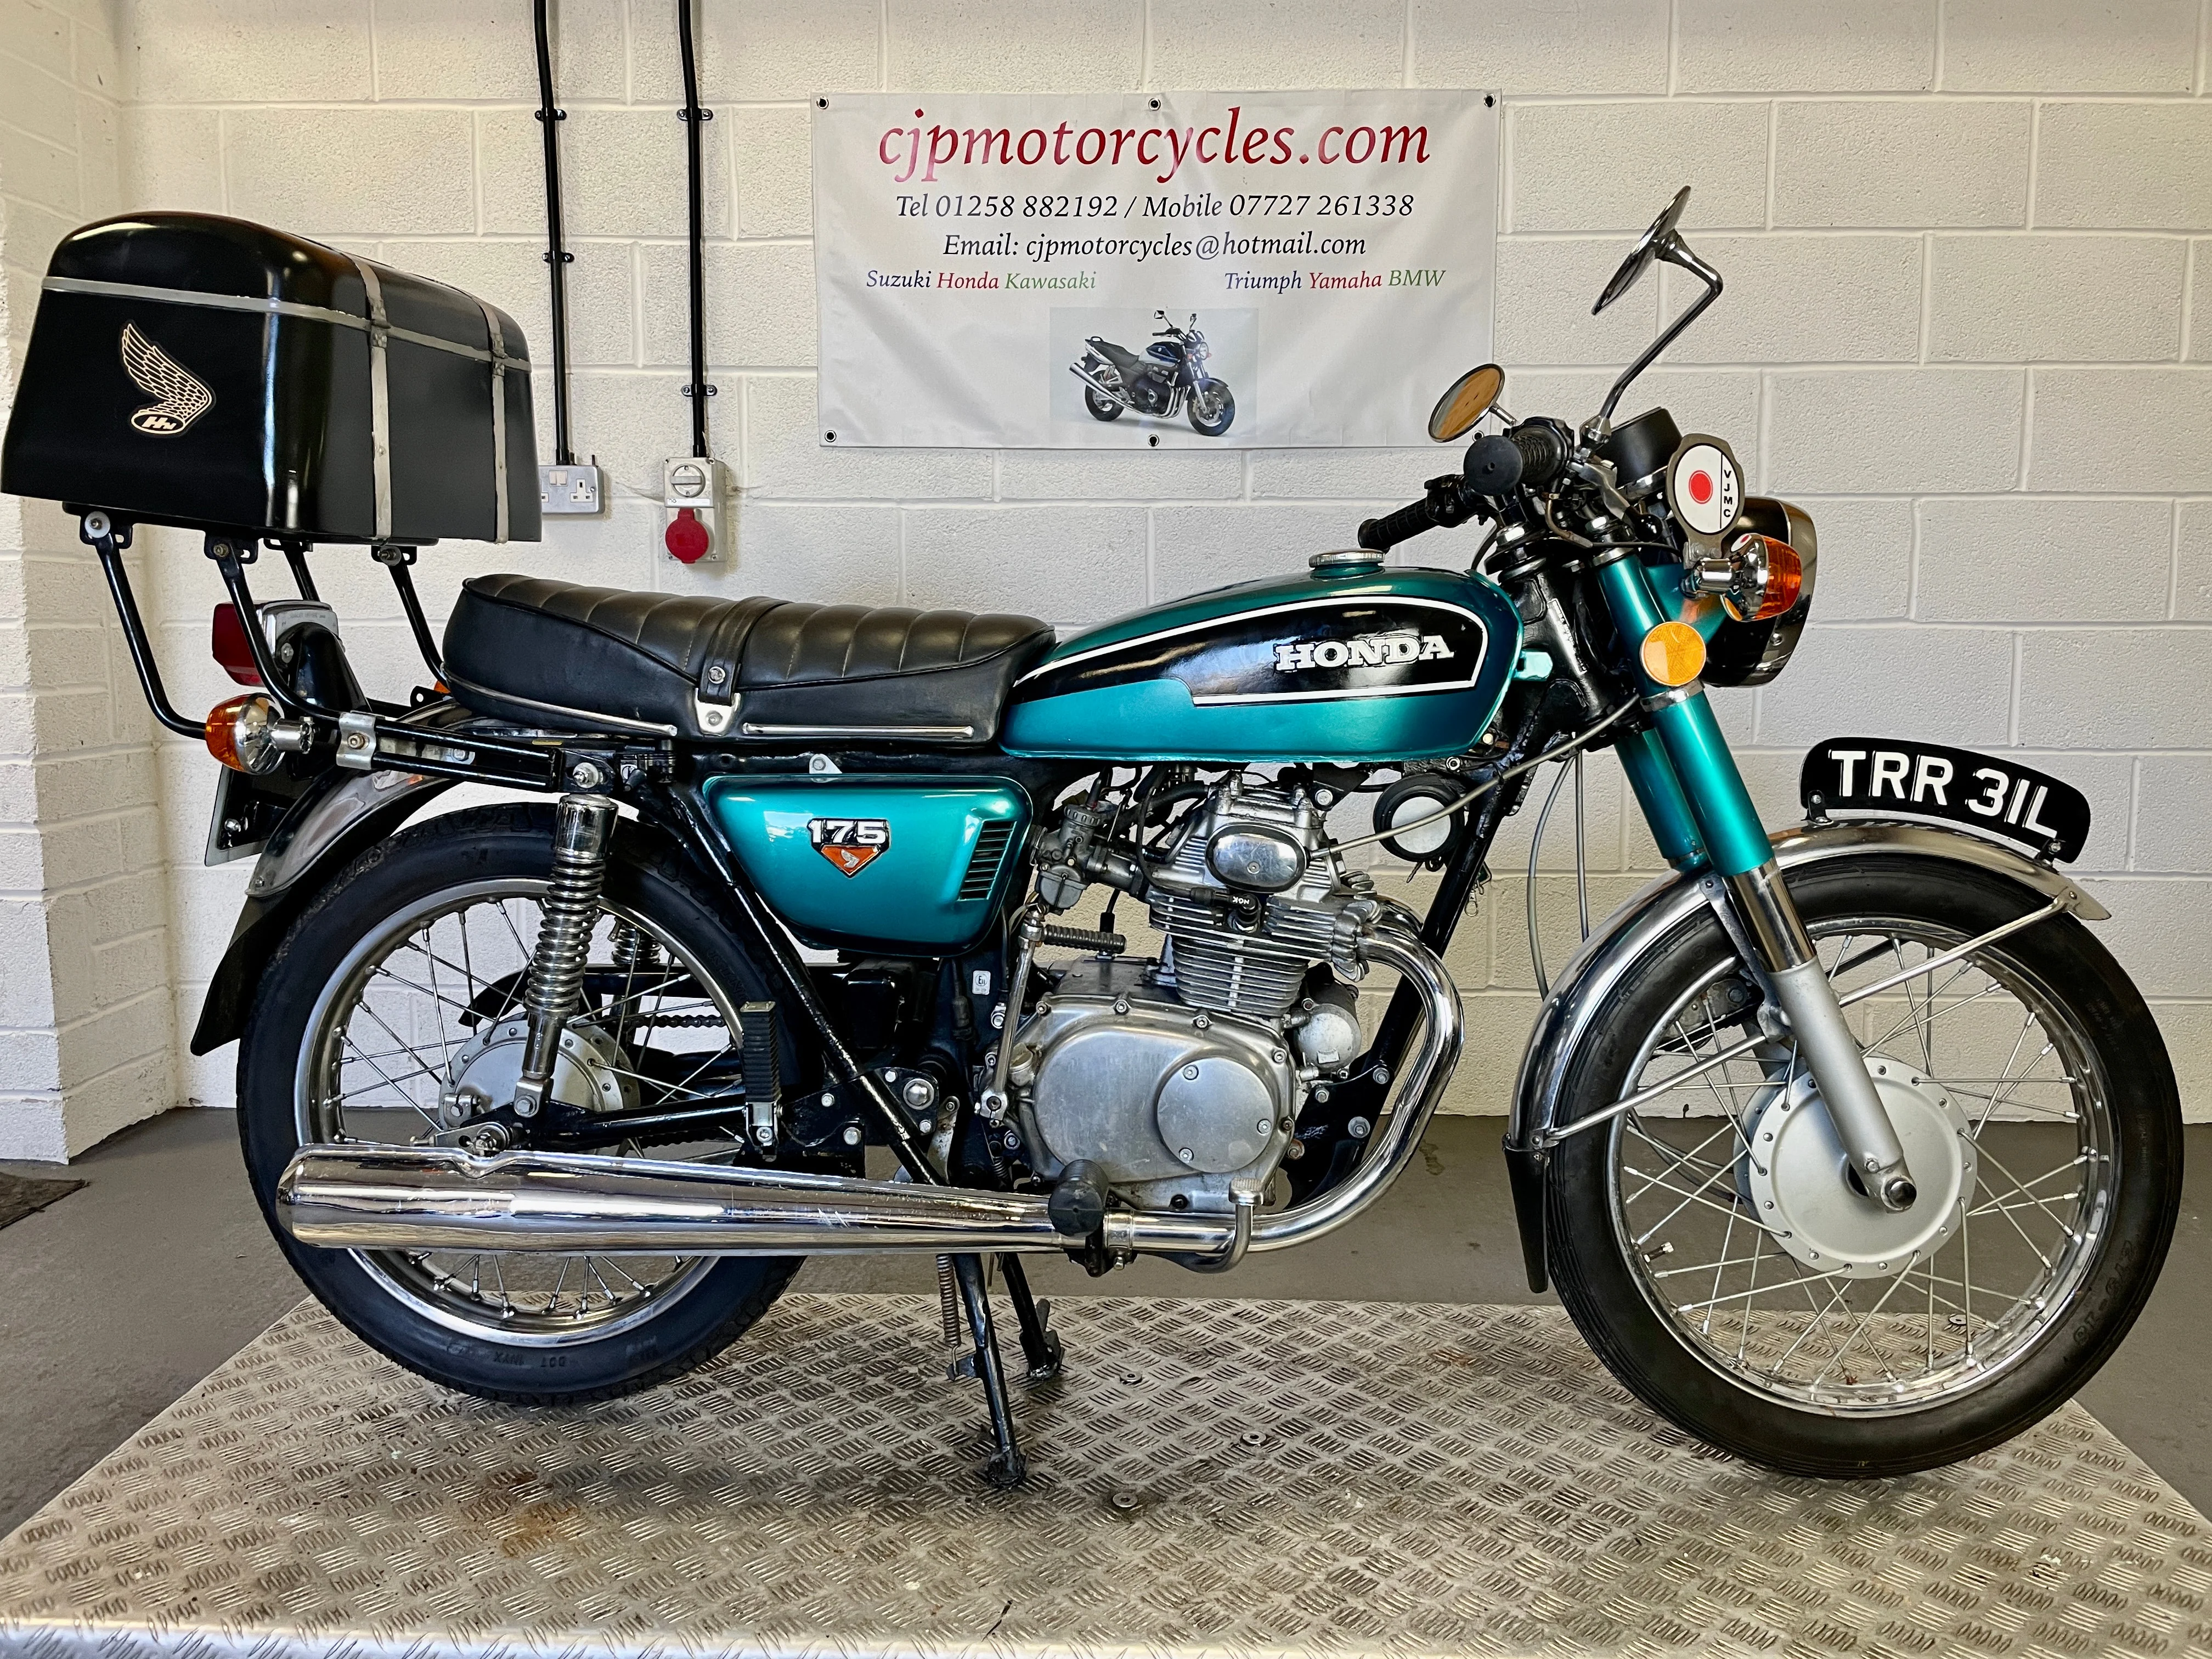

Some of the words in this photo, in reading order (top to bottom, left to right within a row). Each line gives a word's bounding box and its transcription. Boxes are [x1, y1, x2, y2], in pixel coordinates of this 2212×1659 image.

[879, 106, 1430, 184] cjpmotorcycles.com
[896, 193, 928, 217] Tel
[936, 195, 1015, 217] 01258
[1023, 195, 1118, 217] 882192
[1124, 196, 1137, 218] /
[1142, 193, 1222, 218] Mobile
[1229, 194, 1311, 216] 07727
[1317, 195, 1414, 216] 261338
[943, 233, 1018, 256] Email:
[1026, 230, 1365, 263] cjpmotorcycles@hotmail.com
[867, 270, 932, 288] Suzuki
[936, 272, 999, 289] Honda
[1005, 271, 1096, 289] Kawasaki
[1224, 270, 1302, 294] Triumph
[1310, 270, 1382, 289] Yamaha
[1388, 270, 1446, 286] BMW
[1274, 635, 1455, 672] HONDA
[1829, 749, 1954, 805] TRR
[1965, 768, 2058, 838] 31L
[809, 820, 887, 844] 175
